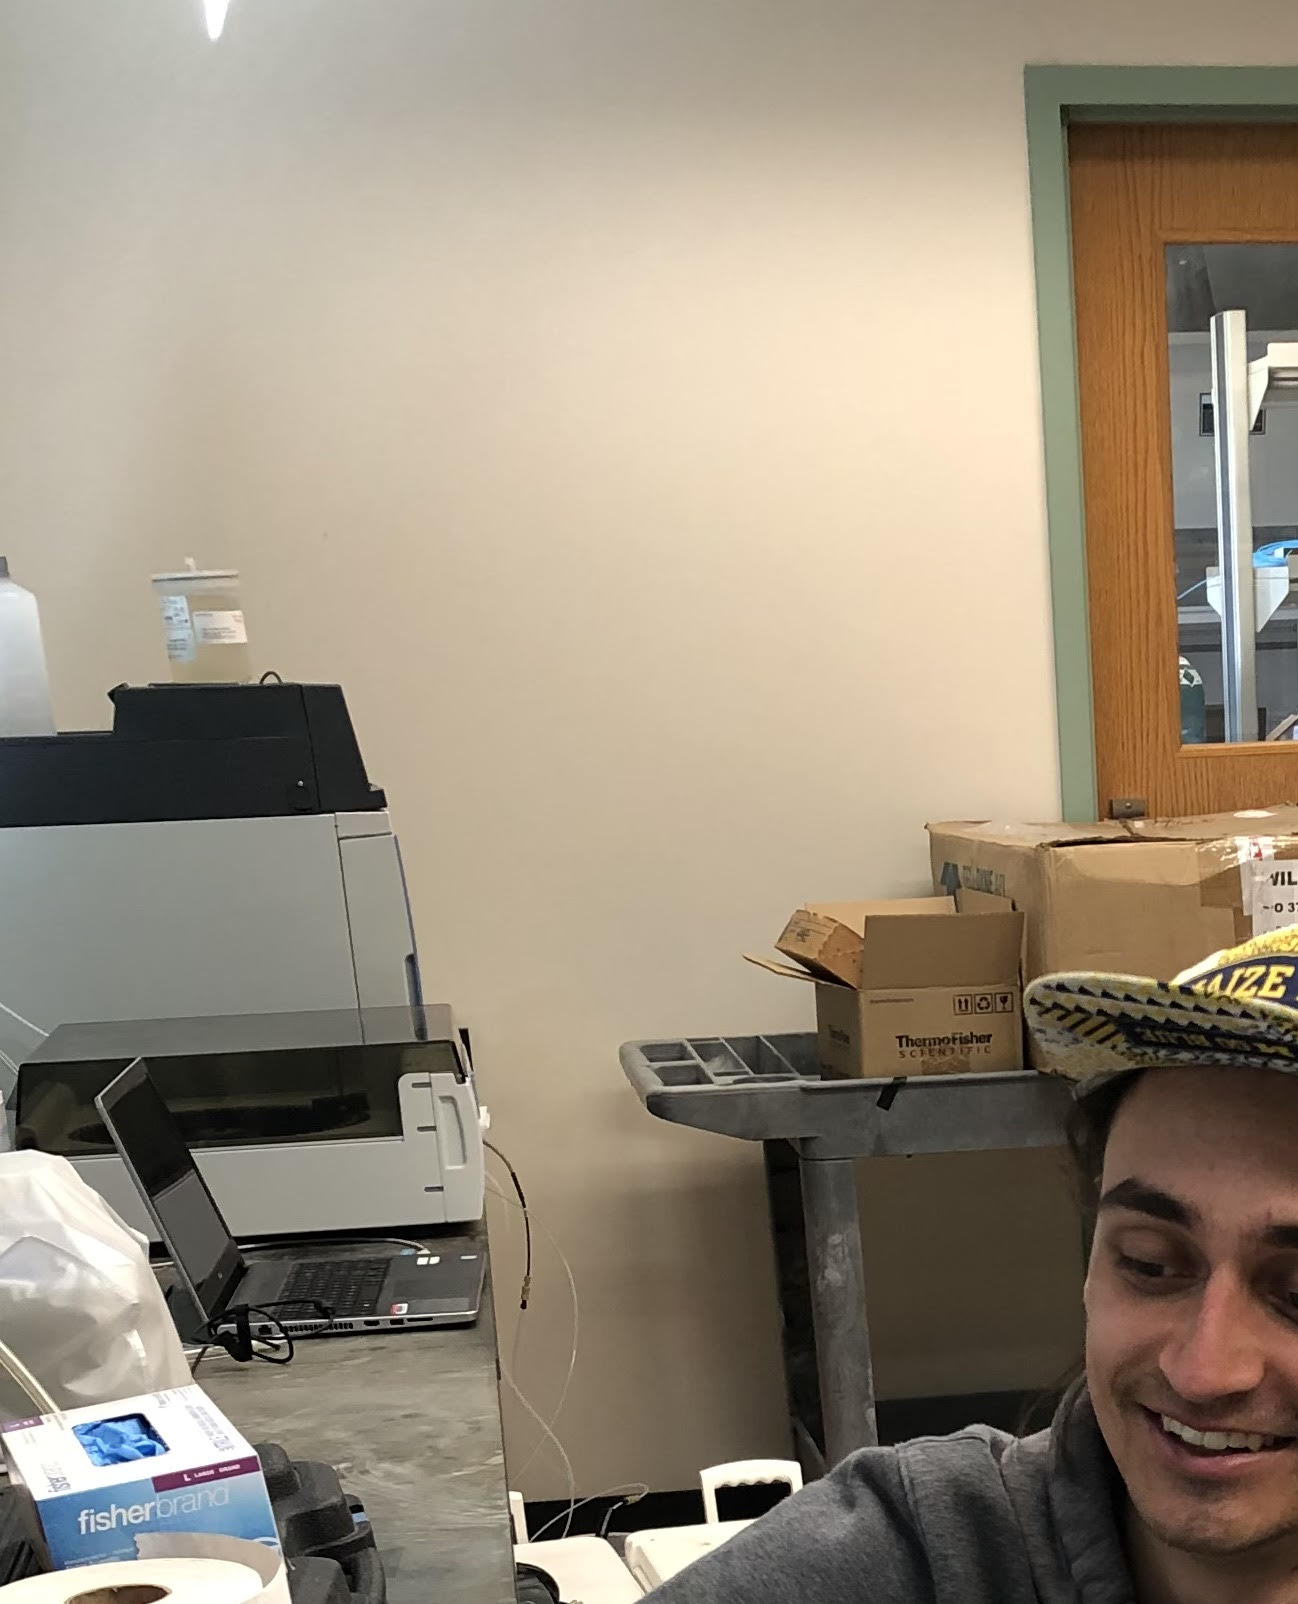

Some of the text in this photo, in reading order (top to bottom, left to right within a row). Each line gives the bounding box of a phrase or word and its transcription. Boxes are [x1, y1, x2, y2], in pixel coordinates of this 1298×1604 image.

[895, 1032, 993, 1049] ThermoFisher
[899, 1045, 992, 1059] SCIENTIFIC
[183, 1473, 192, 1482] L
[77, 1481, 229, 1535] fisherbrand
